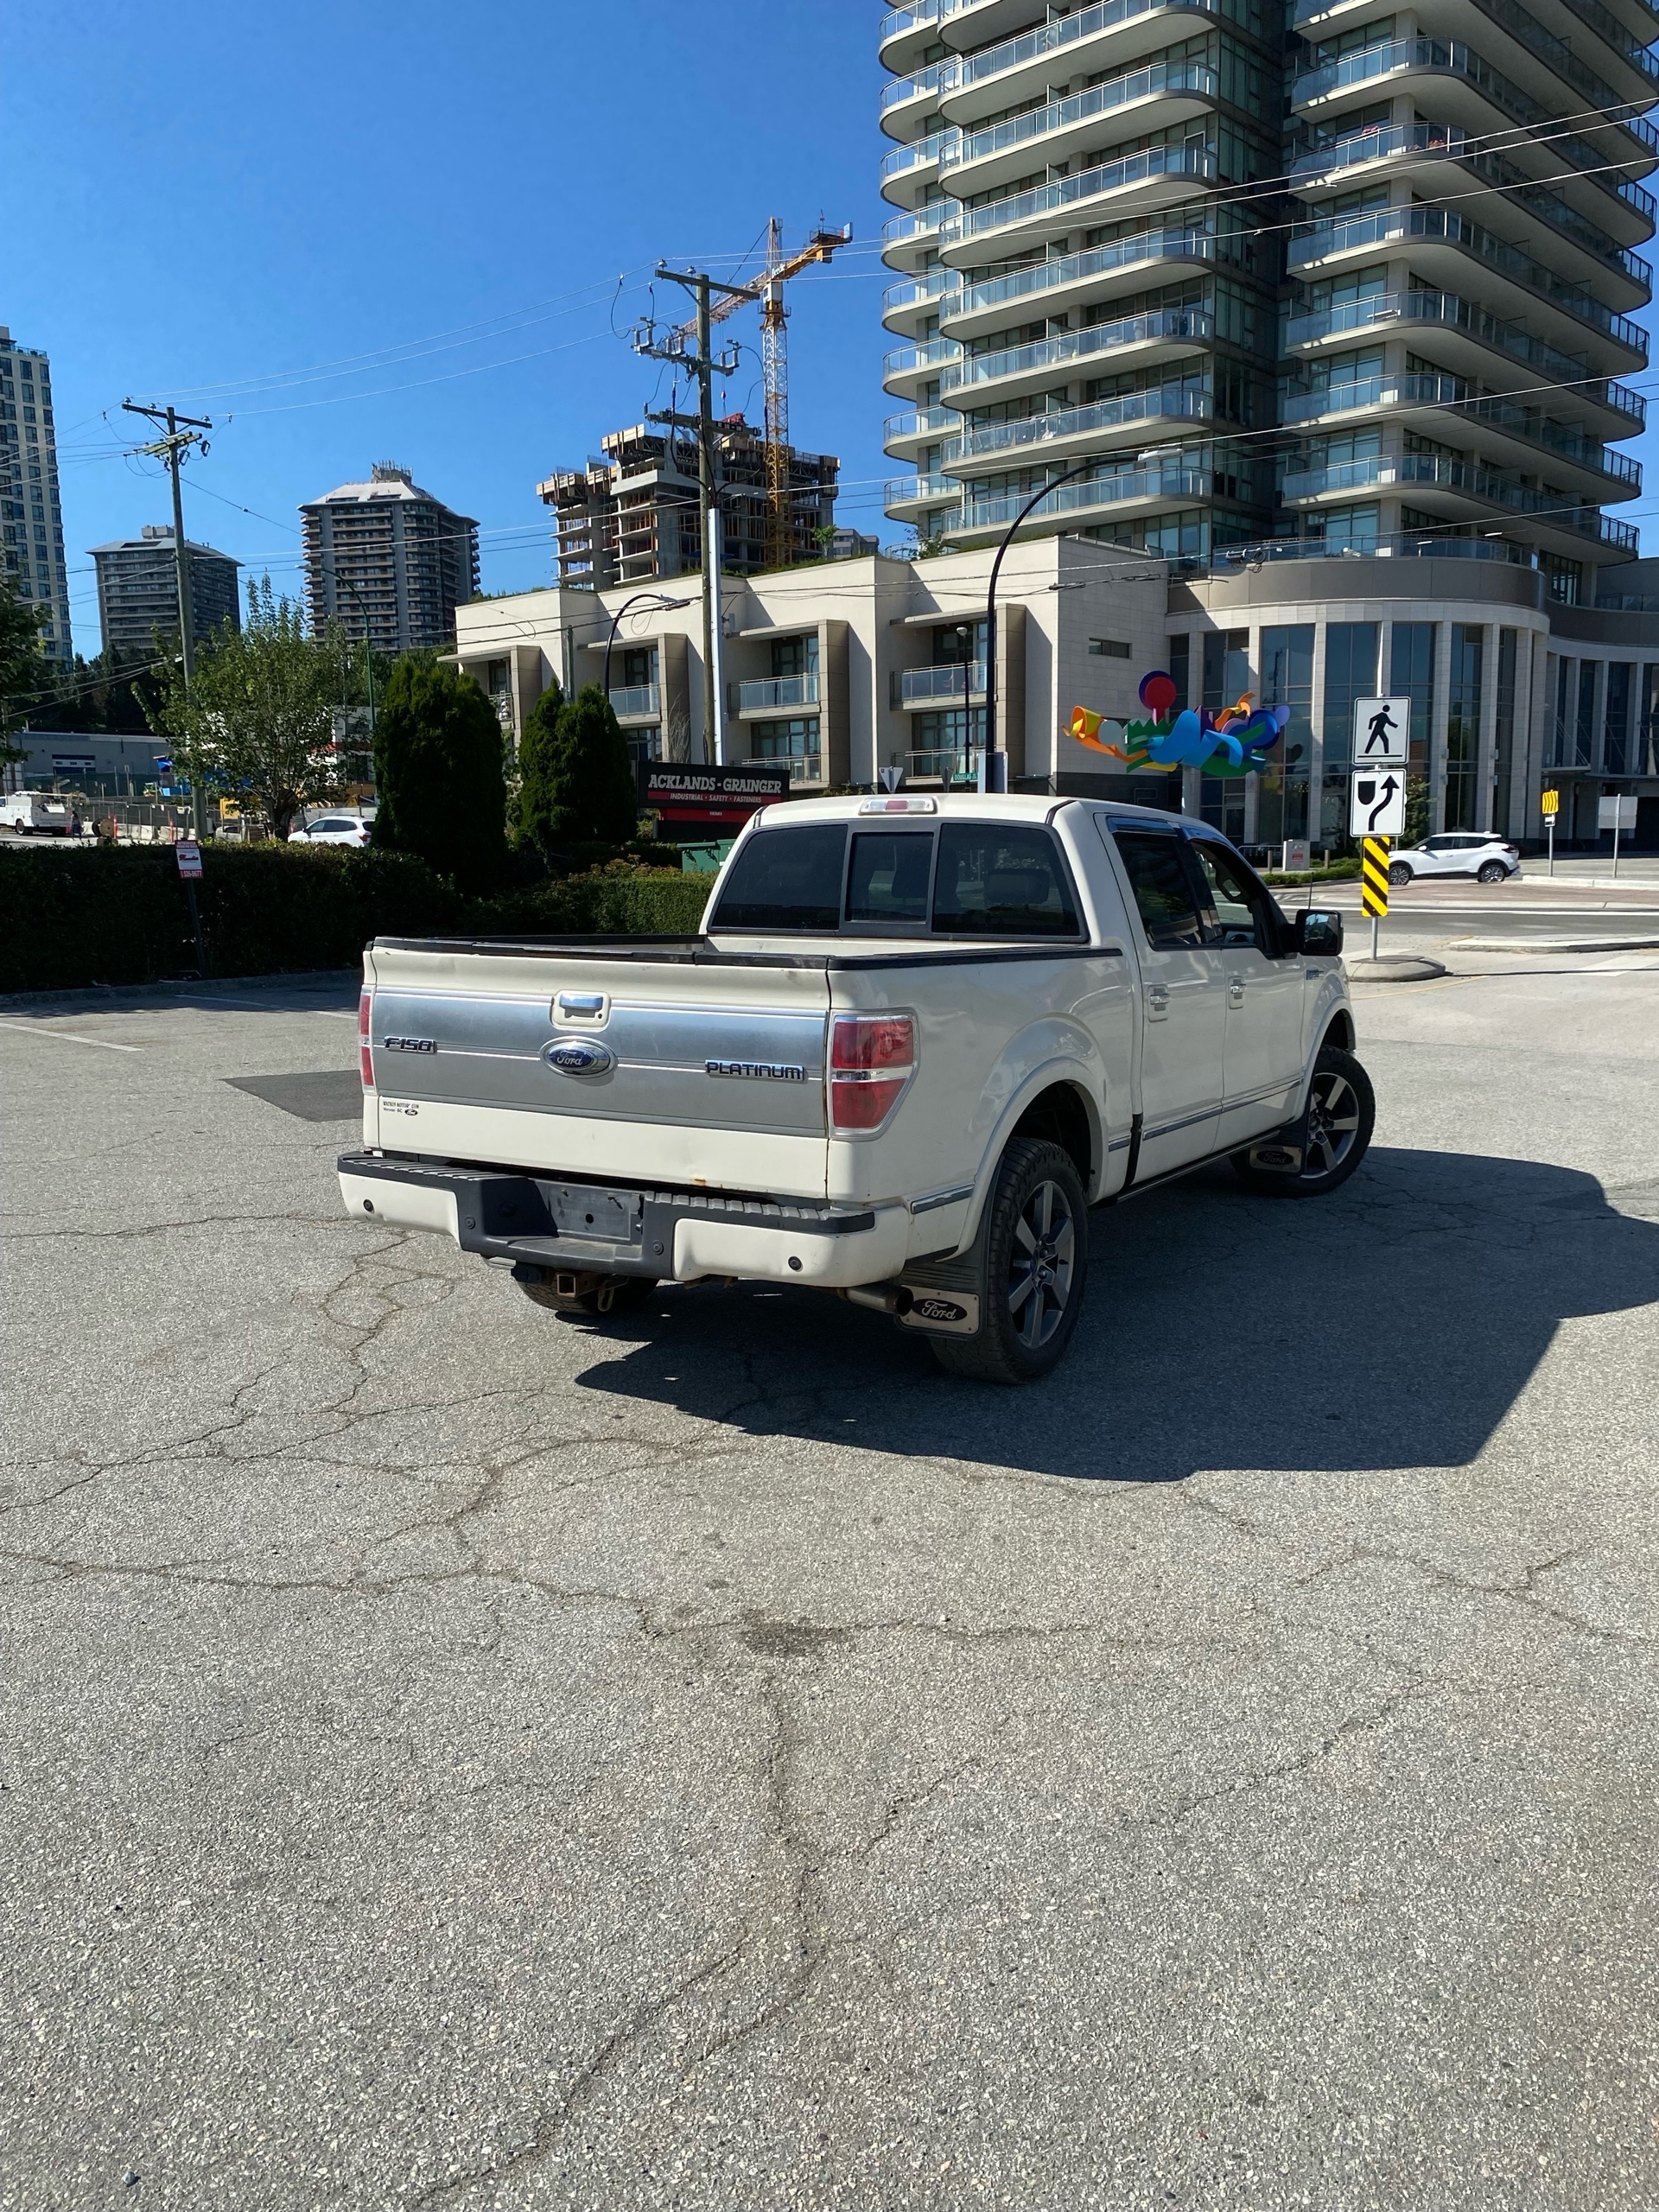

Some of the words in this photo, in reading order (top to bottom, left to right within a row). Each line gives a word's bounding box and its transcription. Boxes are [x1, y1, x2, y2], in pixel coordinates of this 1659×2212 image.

[670, 792, 703, 802] INDUSTRIAL
[709, 794, 728, 803] SAFETY
[556, 1050, 583, 1066] Ford
[707, 1061, 801, 1079] PLATINUM
[1263, 1152, 1287, 1164] Ford
[921, 1300, 957, 1320] Ford
